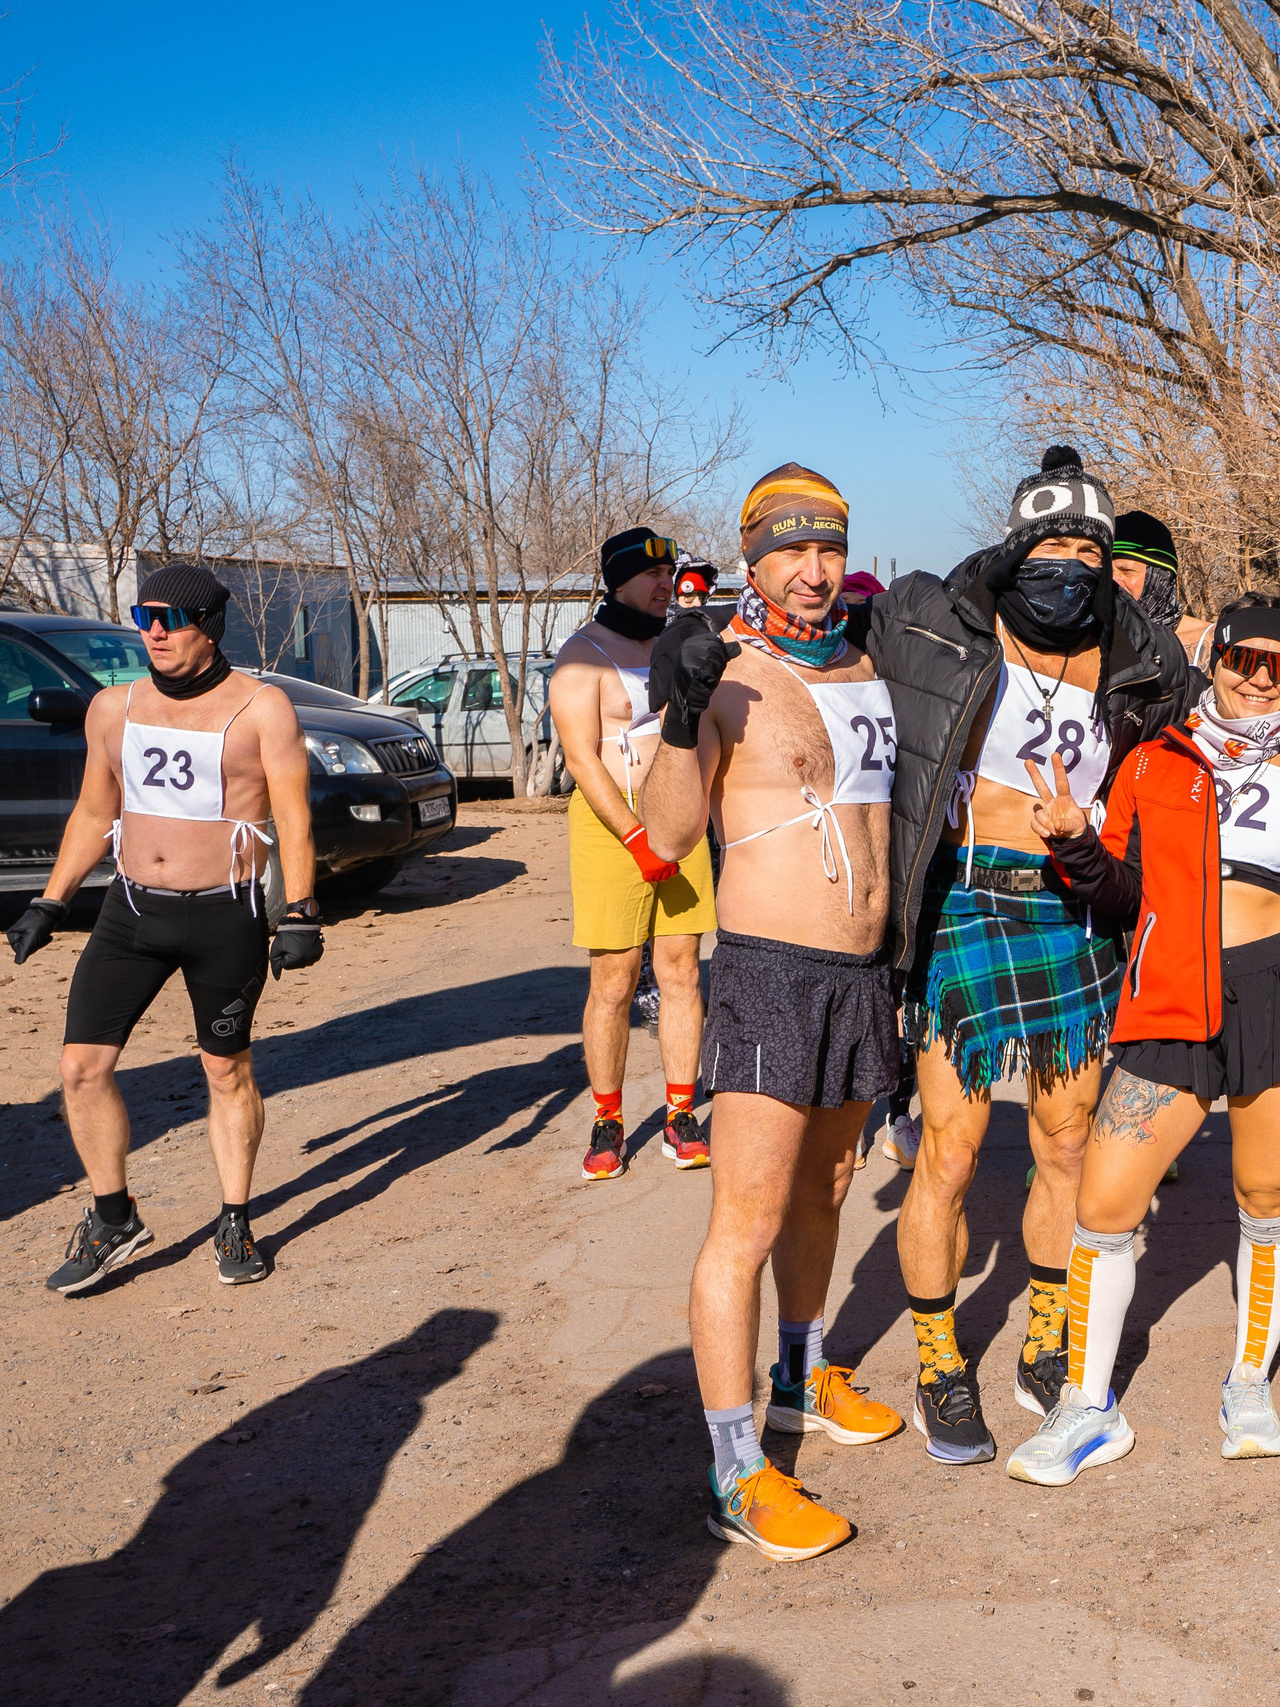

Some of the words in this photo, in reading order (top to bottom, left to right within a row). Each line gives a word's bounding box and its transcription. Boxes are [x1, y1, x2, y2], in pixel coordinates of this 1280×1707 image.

[772, 517, 797, 534] RUN
[850, 715, 898, 772] 25
[1015, 708, 1085, 774] 28
[142, 747, 195, 791] 23
